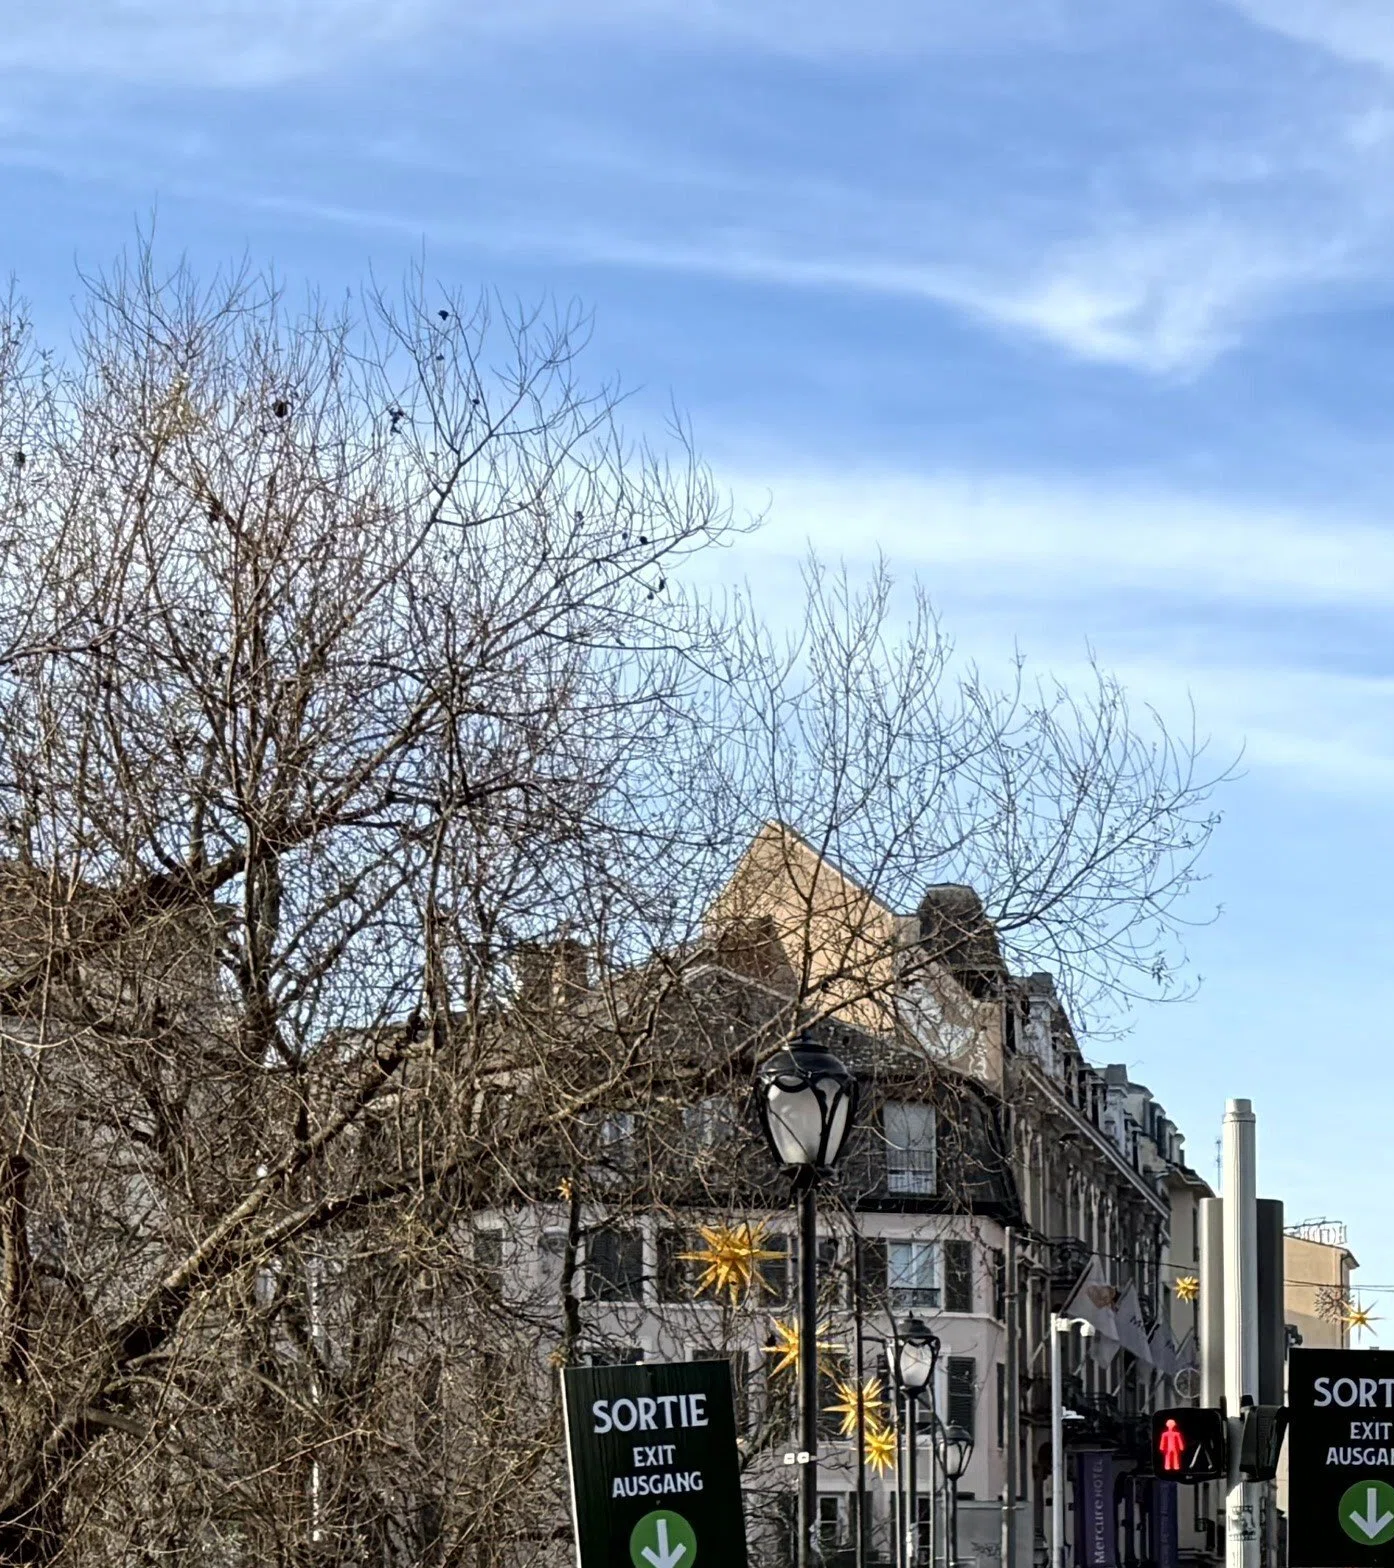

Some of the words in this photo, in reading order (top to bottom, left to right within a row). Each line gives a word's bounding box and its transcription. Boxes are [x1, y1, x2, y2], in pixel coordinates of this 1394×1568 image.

[592, 1393, 709, 1434] SORTIE
[1350, 1421, 1393, 1440] EXIT
[632, 1444, 676, 1467] EXIT
[611, 1471, 704, 1499] AUSGANG
